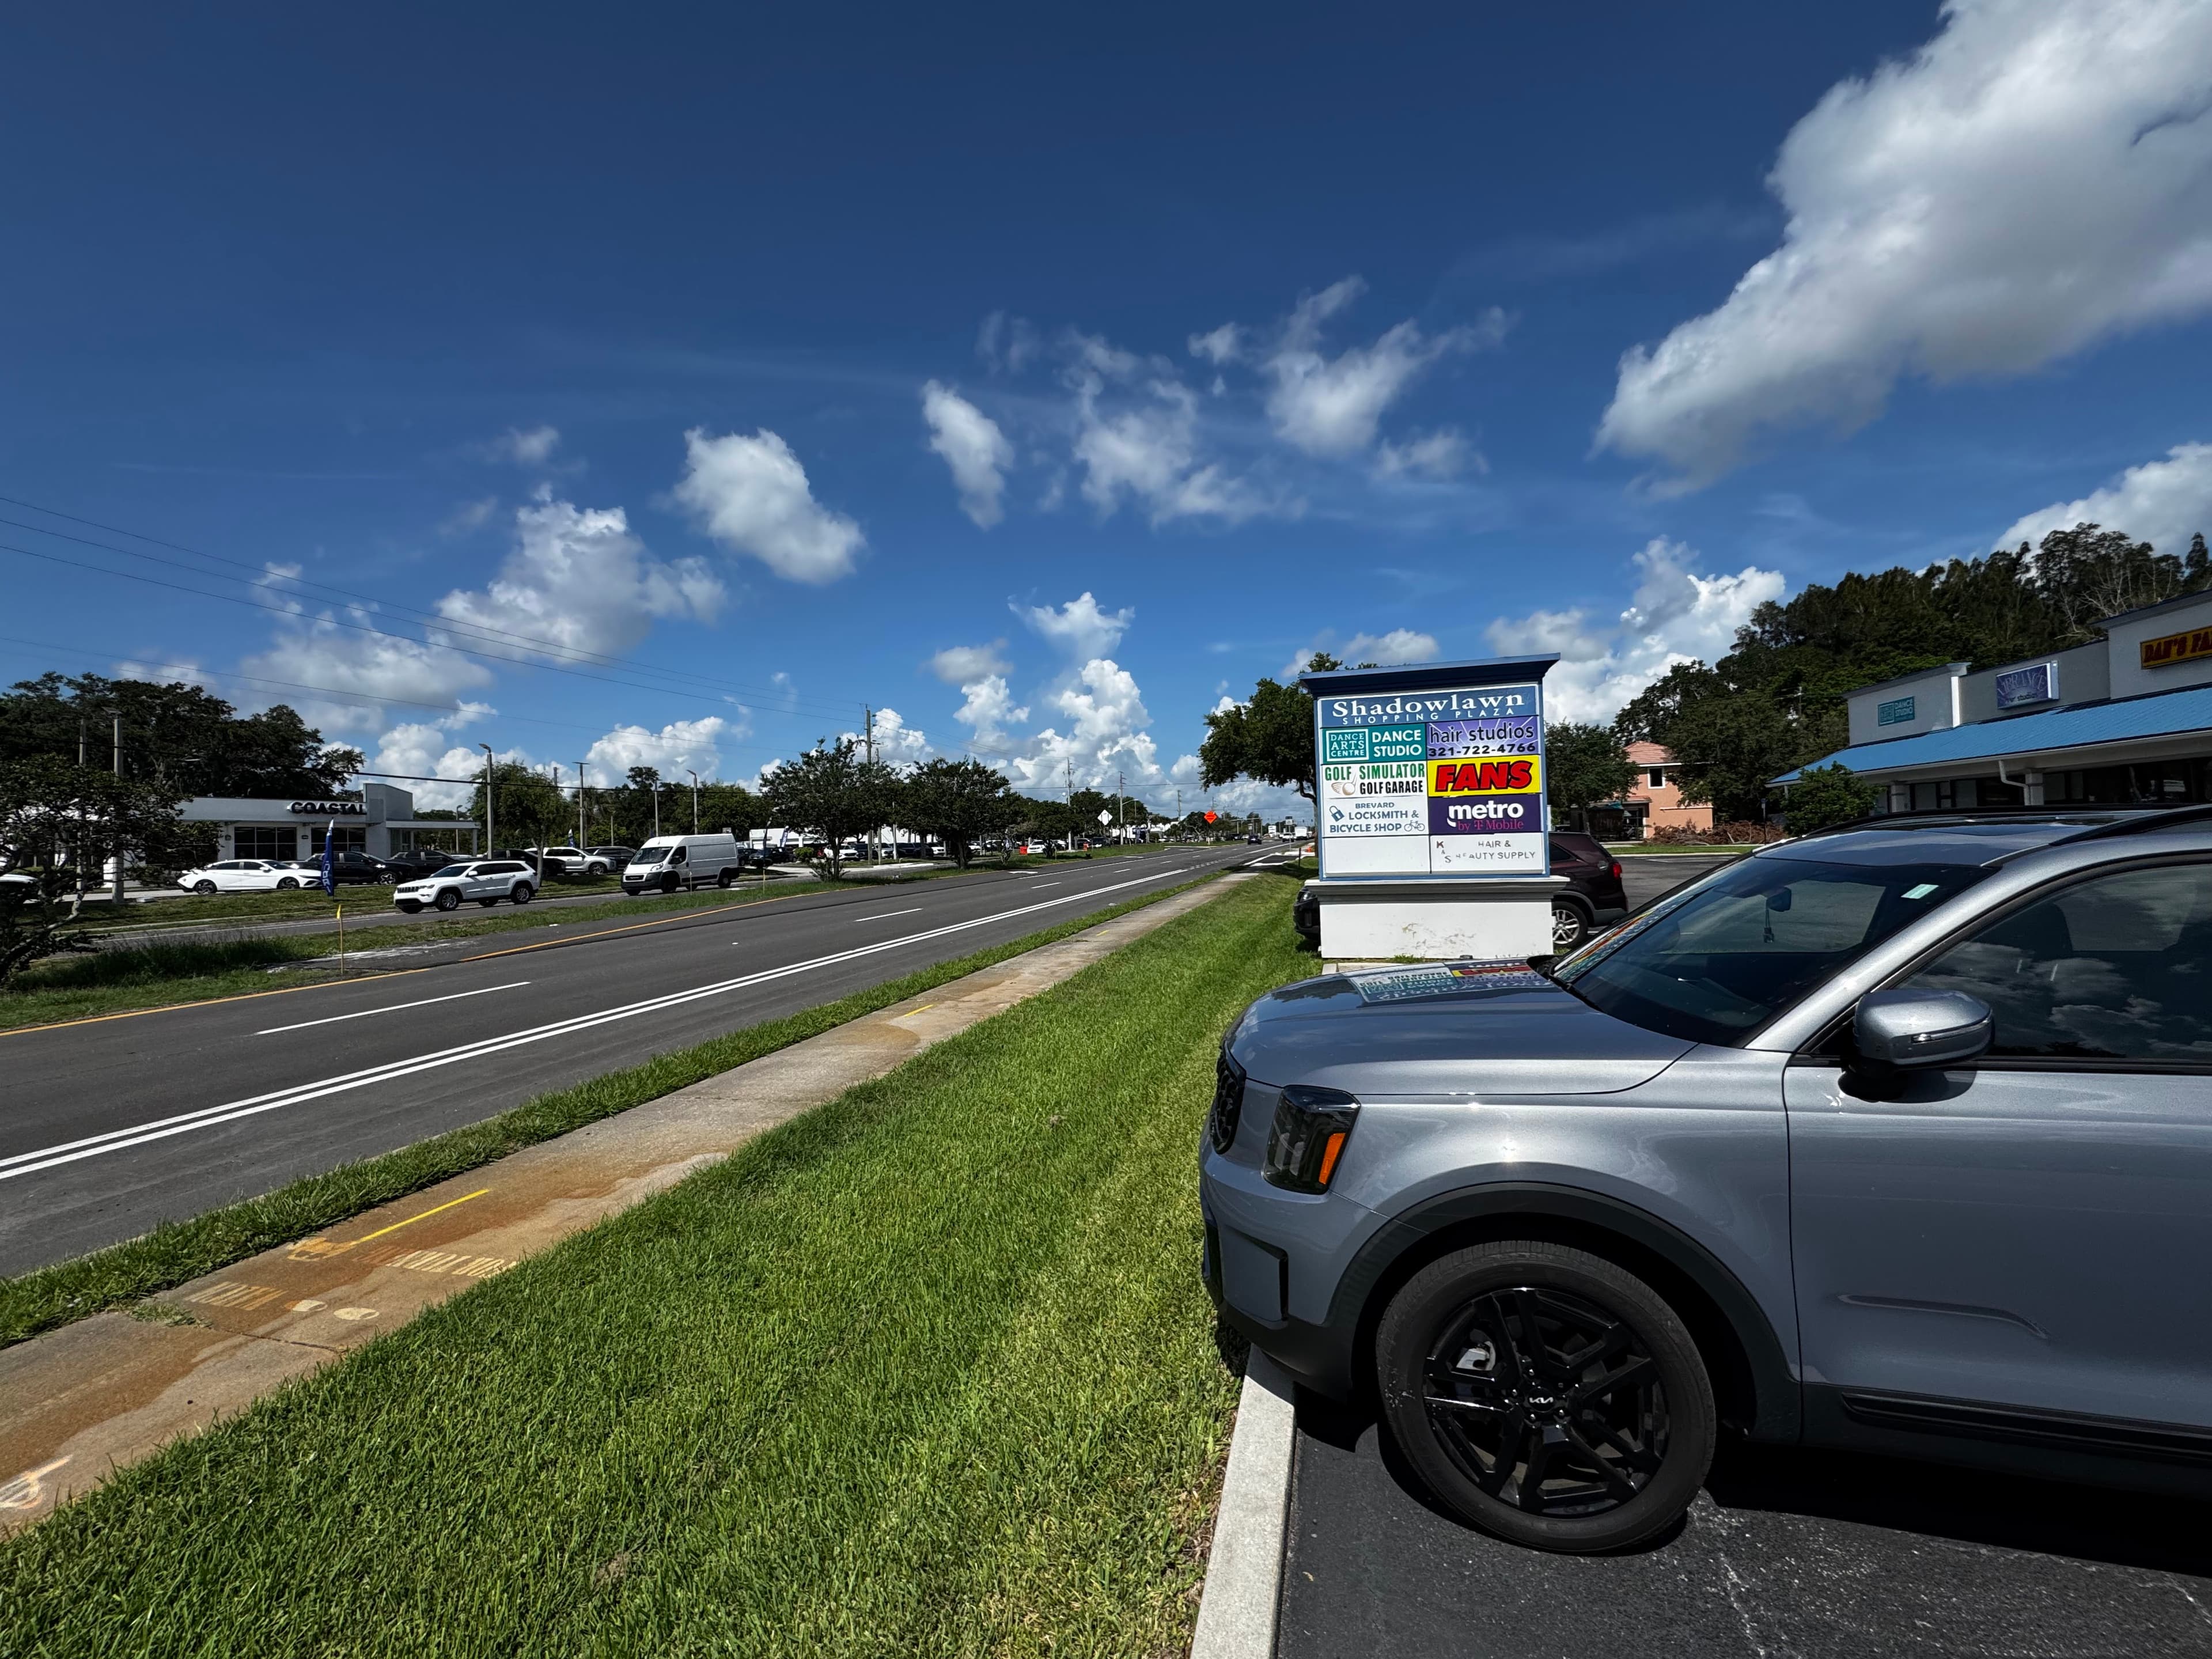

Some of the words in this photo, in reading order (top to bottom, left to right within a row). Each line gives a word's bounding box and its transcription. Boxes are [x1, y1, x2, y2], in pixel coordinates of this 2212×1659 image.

[2190, 631, 2212, 654] FA
[1332, 694, 1525, 717] Shadowlawn
[1343, 712, 1438, 725] SHOPPING
[1456, 708, 1514, 718] PLAZA
[1372, 729, 1421, 743] DANCE
[1430, 726, 1462, 743] hair
[1469, 722, 1533, 741] studios
[1331, 740, 1365, 750] ARTS
[1374, 744, 1422, 757] STUDIO
[1429, 743, 1535, 756] 321-722-4766
[1325, 766, 1351, 781] GOLF
[1359, 763, 1425, 779] SIMULATOR
[1435, 760, 1533, 792] FANS
[1360, 782, 1383, 794] GOLF
[1385, 781, 1423, 794] GARAGE
[290, 801, 368, 815] COASTAL
[1349, 810, 1408, 820] LOCKSMITH
[1411, 810, 1419, 818] &
[1448, 800, 1524, 820] metro
[1330, 824, 1372, 833] BICYCLE
[1374, 823, 1402, 832] SHOP
[1458, 821, 1471, 832] by
[1497, 851, 1535, 859] SUPPLY
